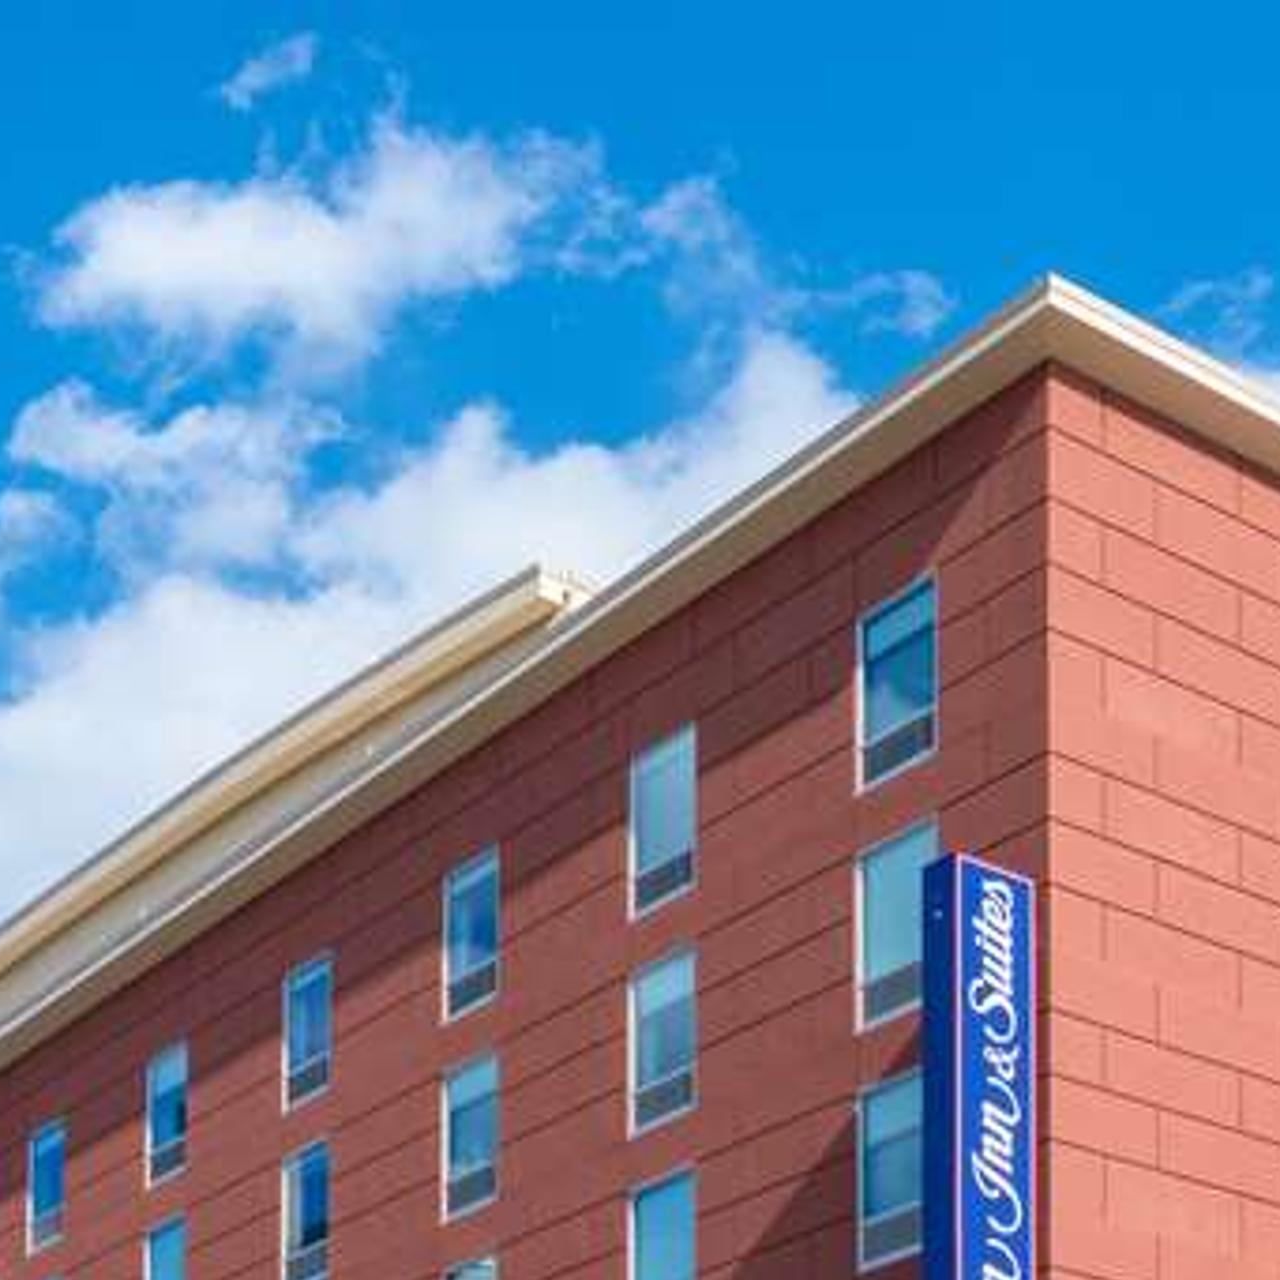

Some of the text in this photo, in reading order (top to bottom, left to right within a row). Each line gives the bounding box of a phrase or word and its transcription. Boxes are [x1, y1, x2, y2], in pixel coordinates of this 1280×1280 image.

[968, 878, 1018, 1044] Suites
[983, 1044, 1021, 1082] &
[971, 1077, 1023, 1234] Inn
